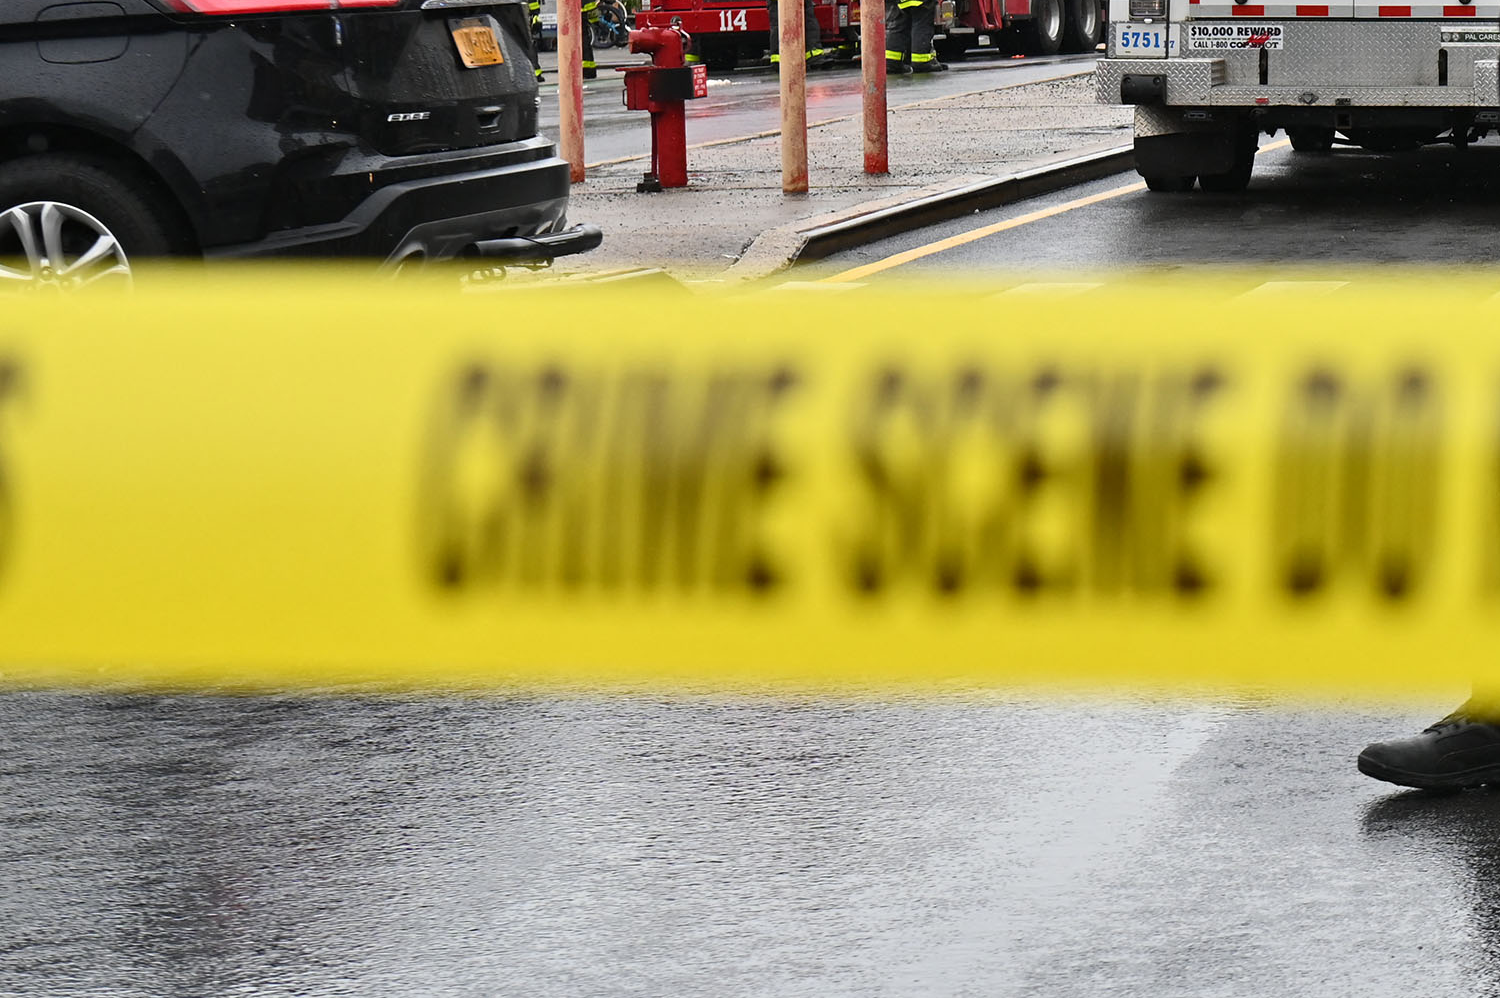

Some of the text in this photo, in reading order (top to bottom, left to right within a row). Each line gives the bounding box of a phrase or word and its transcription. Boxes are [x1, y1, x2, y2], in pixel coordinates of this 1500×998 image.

[719, 10, 748, 31] 114
[1121, 31, 1160, 48] 5751
[1191, 26, 1282, 37] $10,000 REWARD
[1193, 41, 1209, 49] CALL
[1210, 41, 1229, 49] 1-800
[420, 357, 800, 602] CRIME
[838, 357, 1220, 602] SCENE
[1271, 357, 1448, 607] DO
